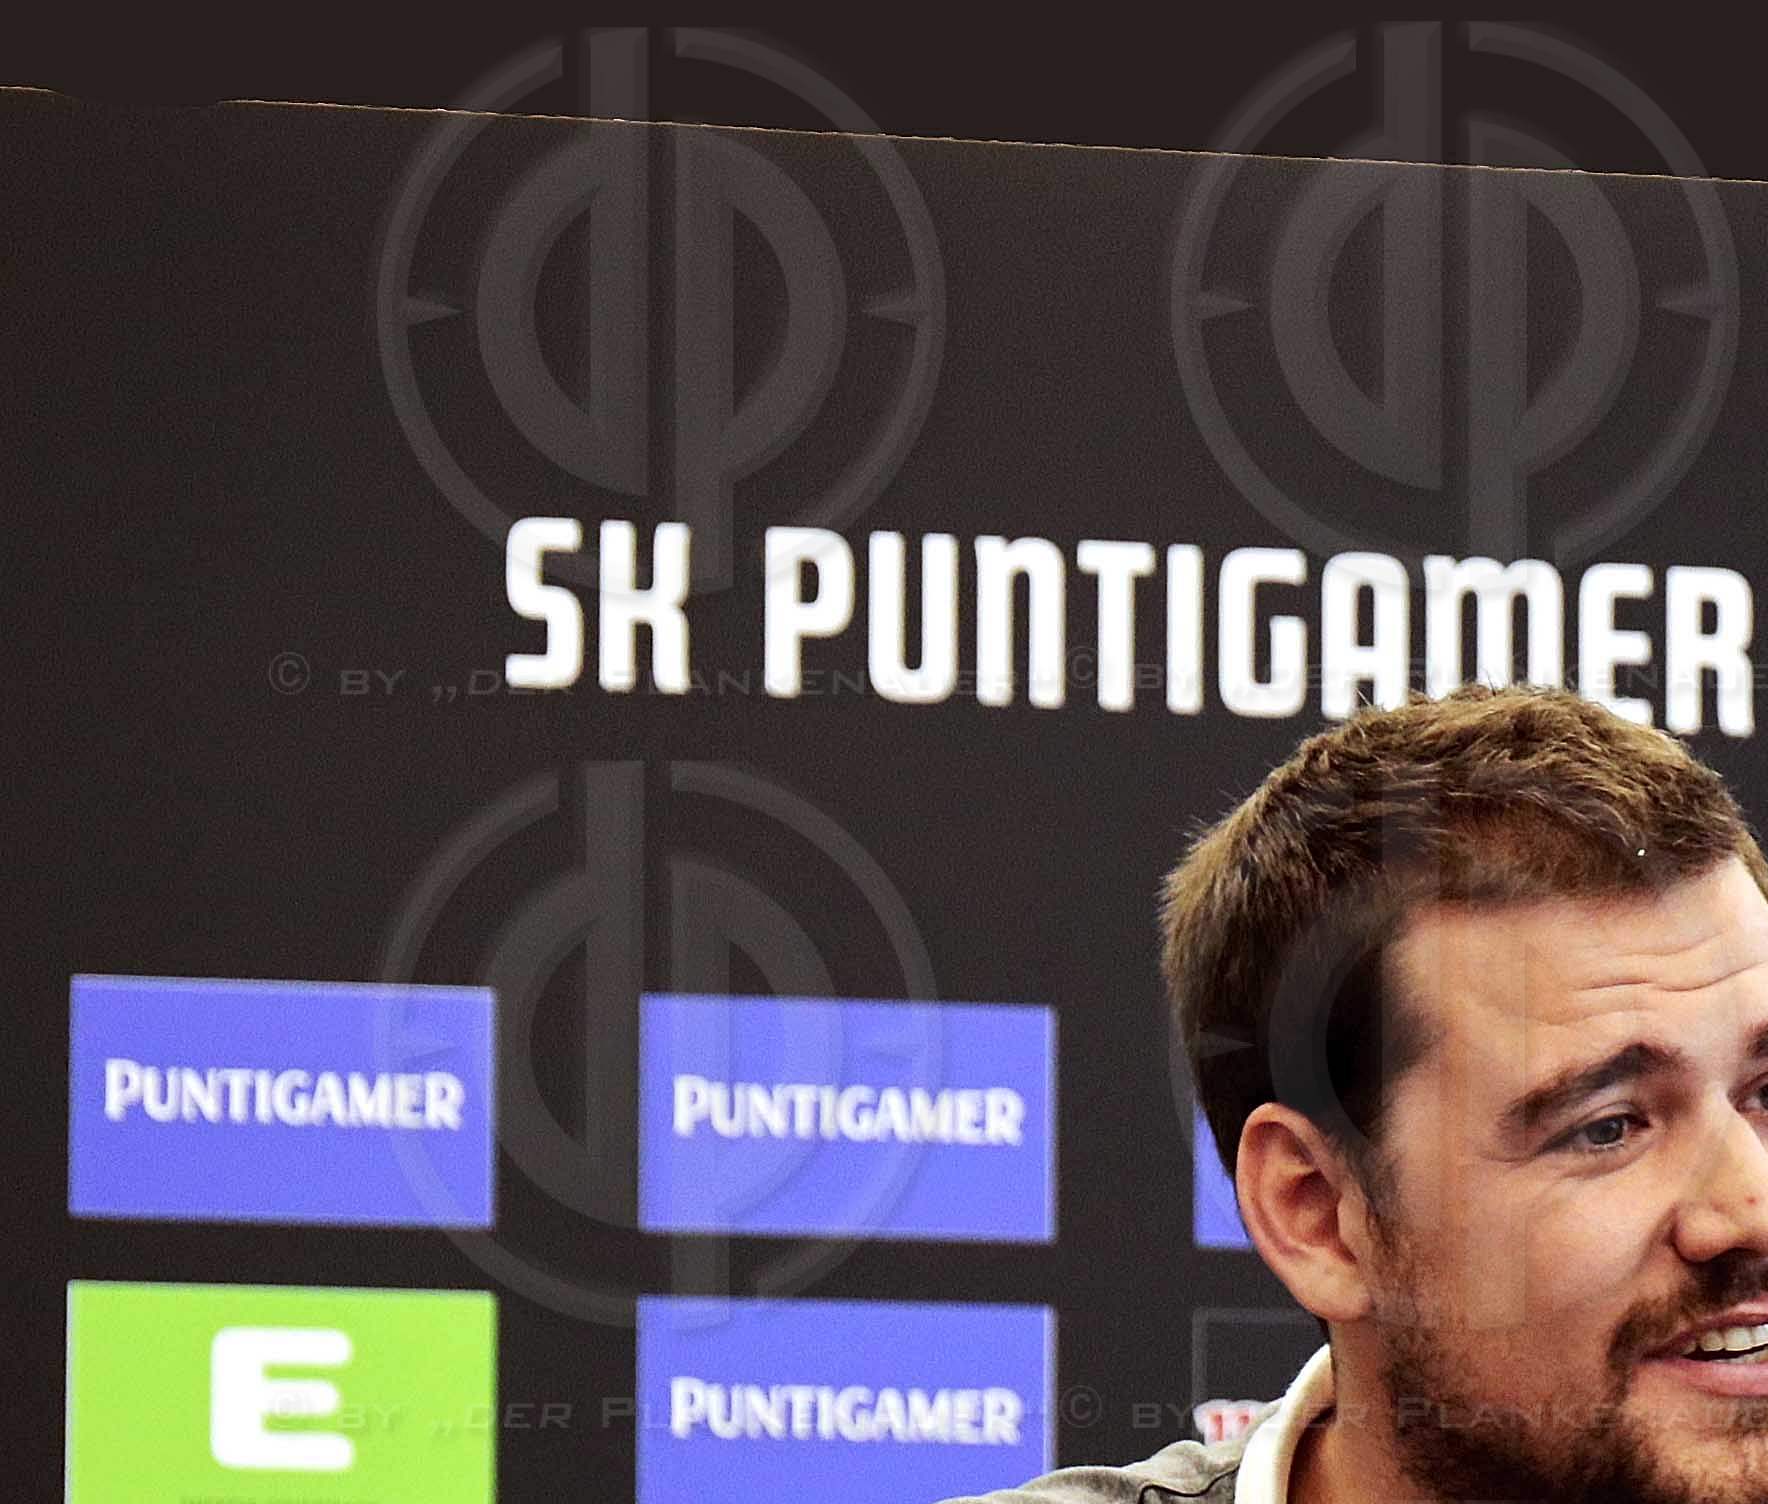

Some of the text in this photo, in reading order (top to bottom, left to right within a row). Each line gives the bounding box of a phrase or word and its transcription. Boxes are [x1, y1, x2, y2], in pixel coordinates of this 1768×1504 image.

[506, 516, 691, 695] SK
[765, 527, 1754, 738] PUNTIGAMER
[103, 1057, 465, 1134] PUNTIGAMER
[671, 1072, 1025, 1147] PUNTIGAMER
[668, 1375, 1023, 1448] PUNTIGAMER
